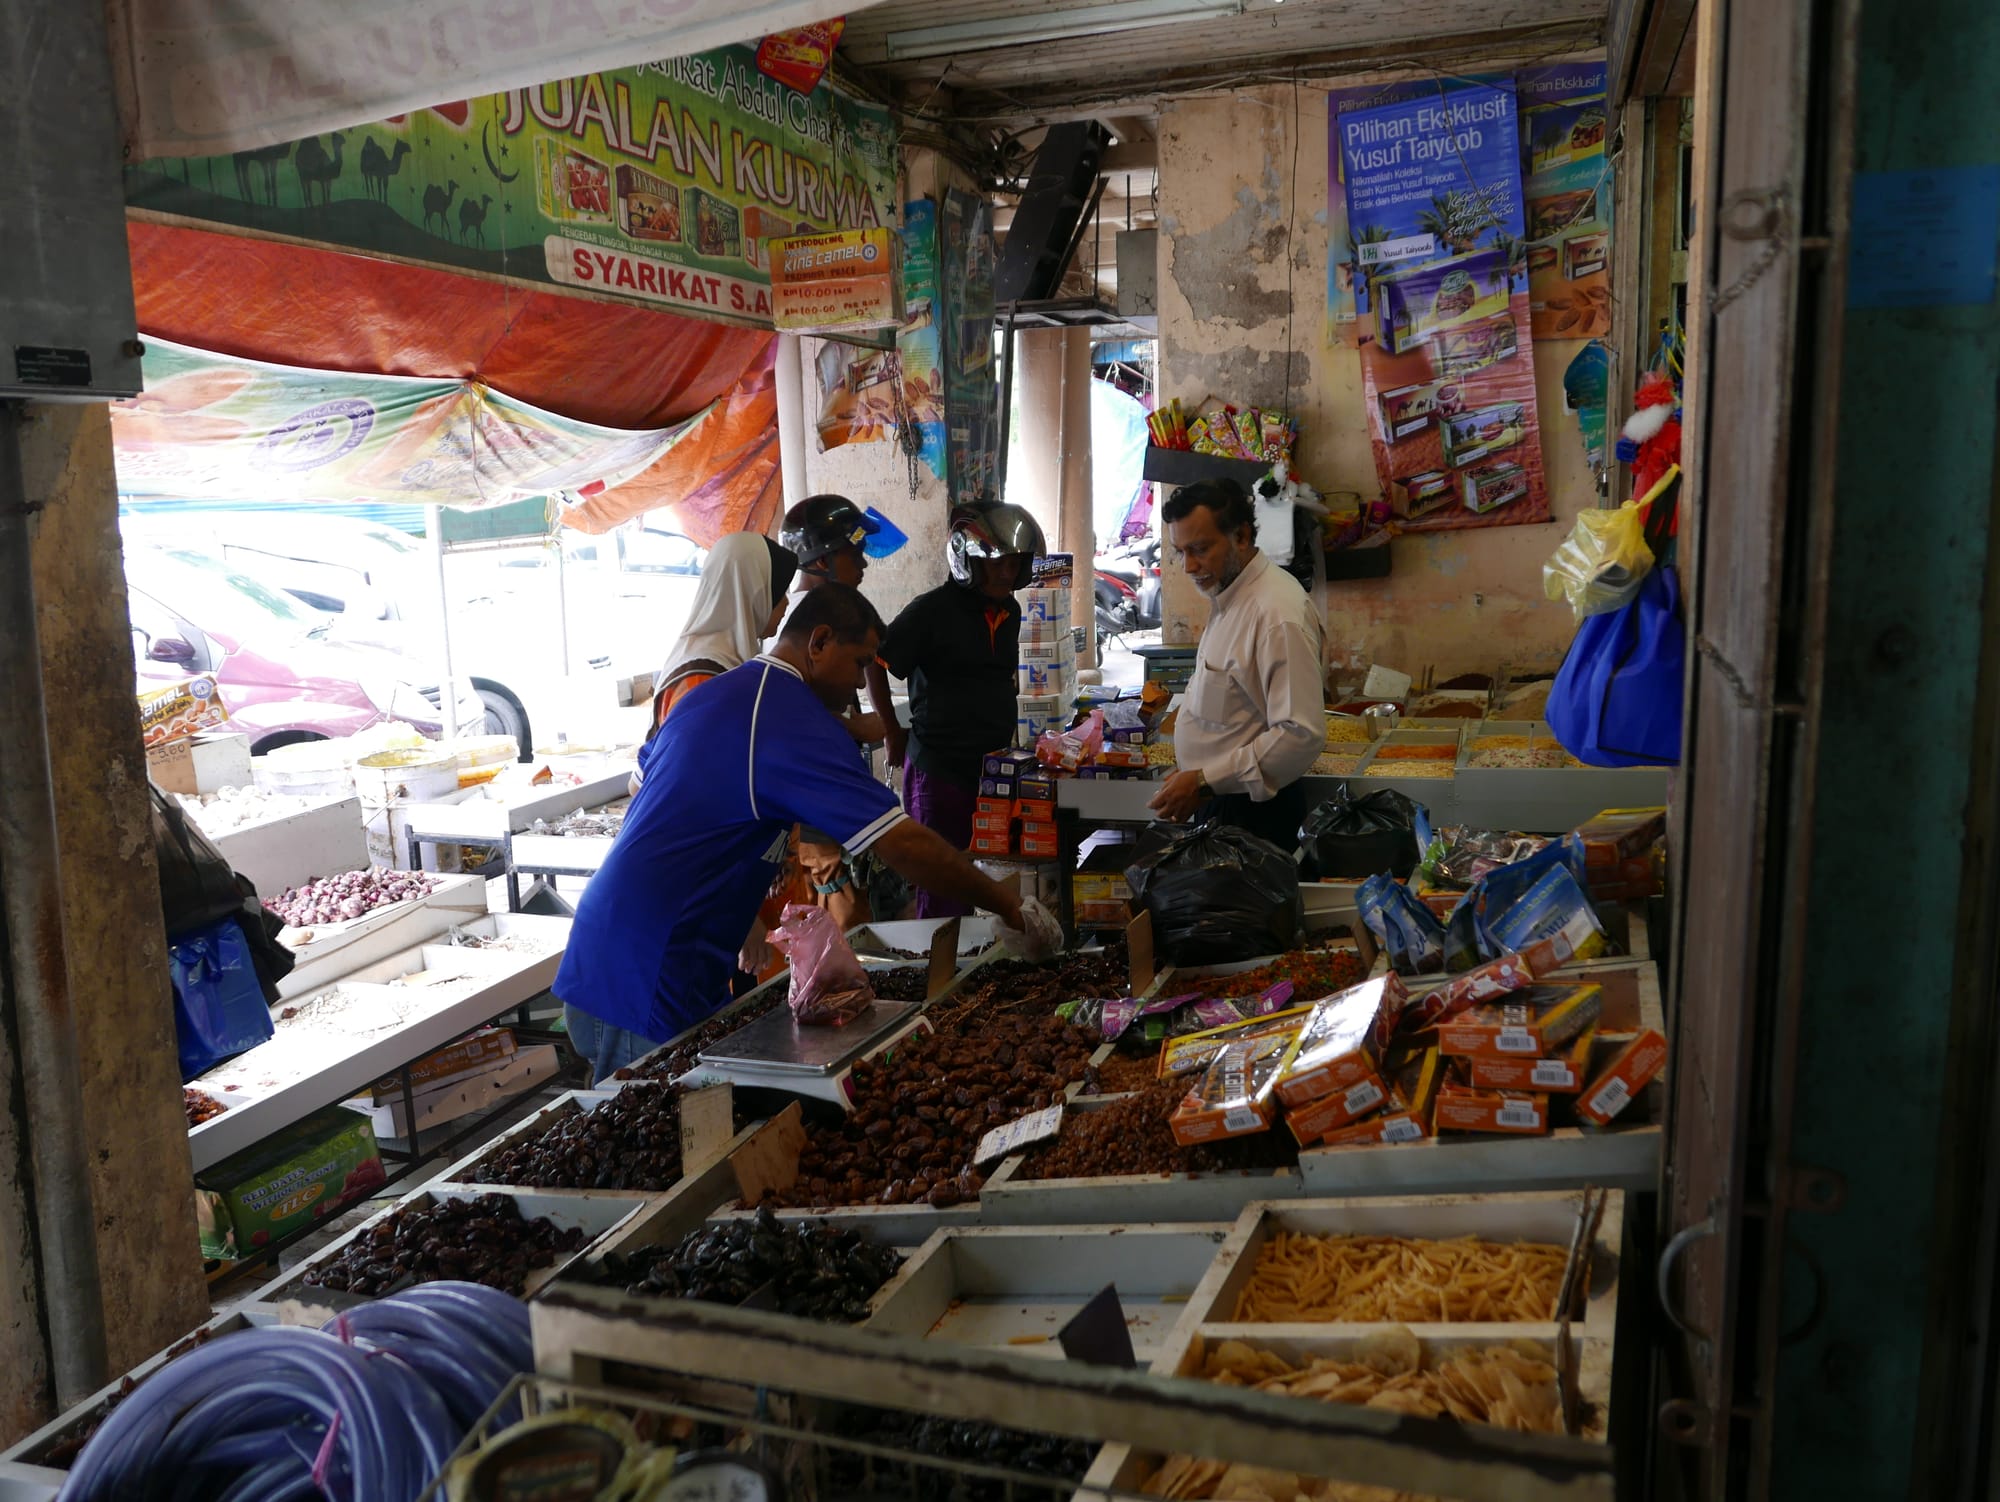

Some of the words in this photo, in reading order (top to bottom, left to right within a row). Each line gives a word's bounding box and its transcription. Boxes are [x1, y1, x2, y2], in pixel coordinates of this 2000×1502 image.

[719, 56, 784, 125] Abdul
[1347, 116, 1411, 146] Pilihan
[1417, 94, 1508, 133] Eksklusif
[504, 72, 722, 185] JUALAN
[732, 129, 881, 229] KURMA
[1349, 142, 1404, 171] Yusuf
[1406, 127, 1482, 161] Taiyoob
[1375, 183, 1401, 195] Kurma
[1402, 178, 1423, 190] Yusuf
[560, 226, 598, 244] PENGEDAR
[573, 248, 721, 305] SYARIKAT
[730, 283, 774, 316] S.A
[784, 254, 813, 272] KING
[242, 1187, 268, 1204] RED
[271, 1167, 306, 1191] DATES
[251, 1180, 303, 1211] WITHOUT
